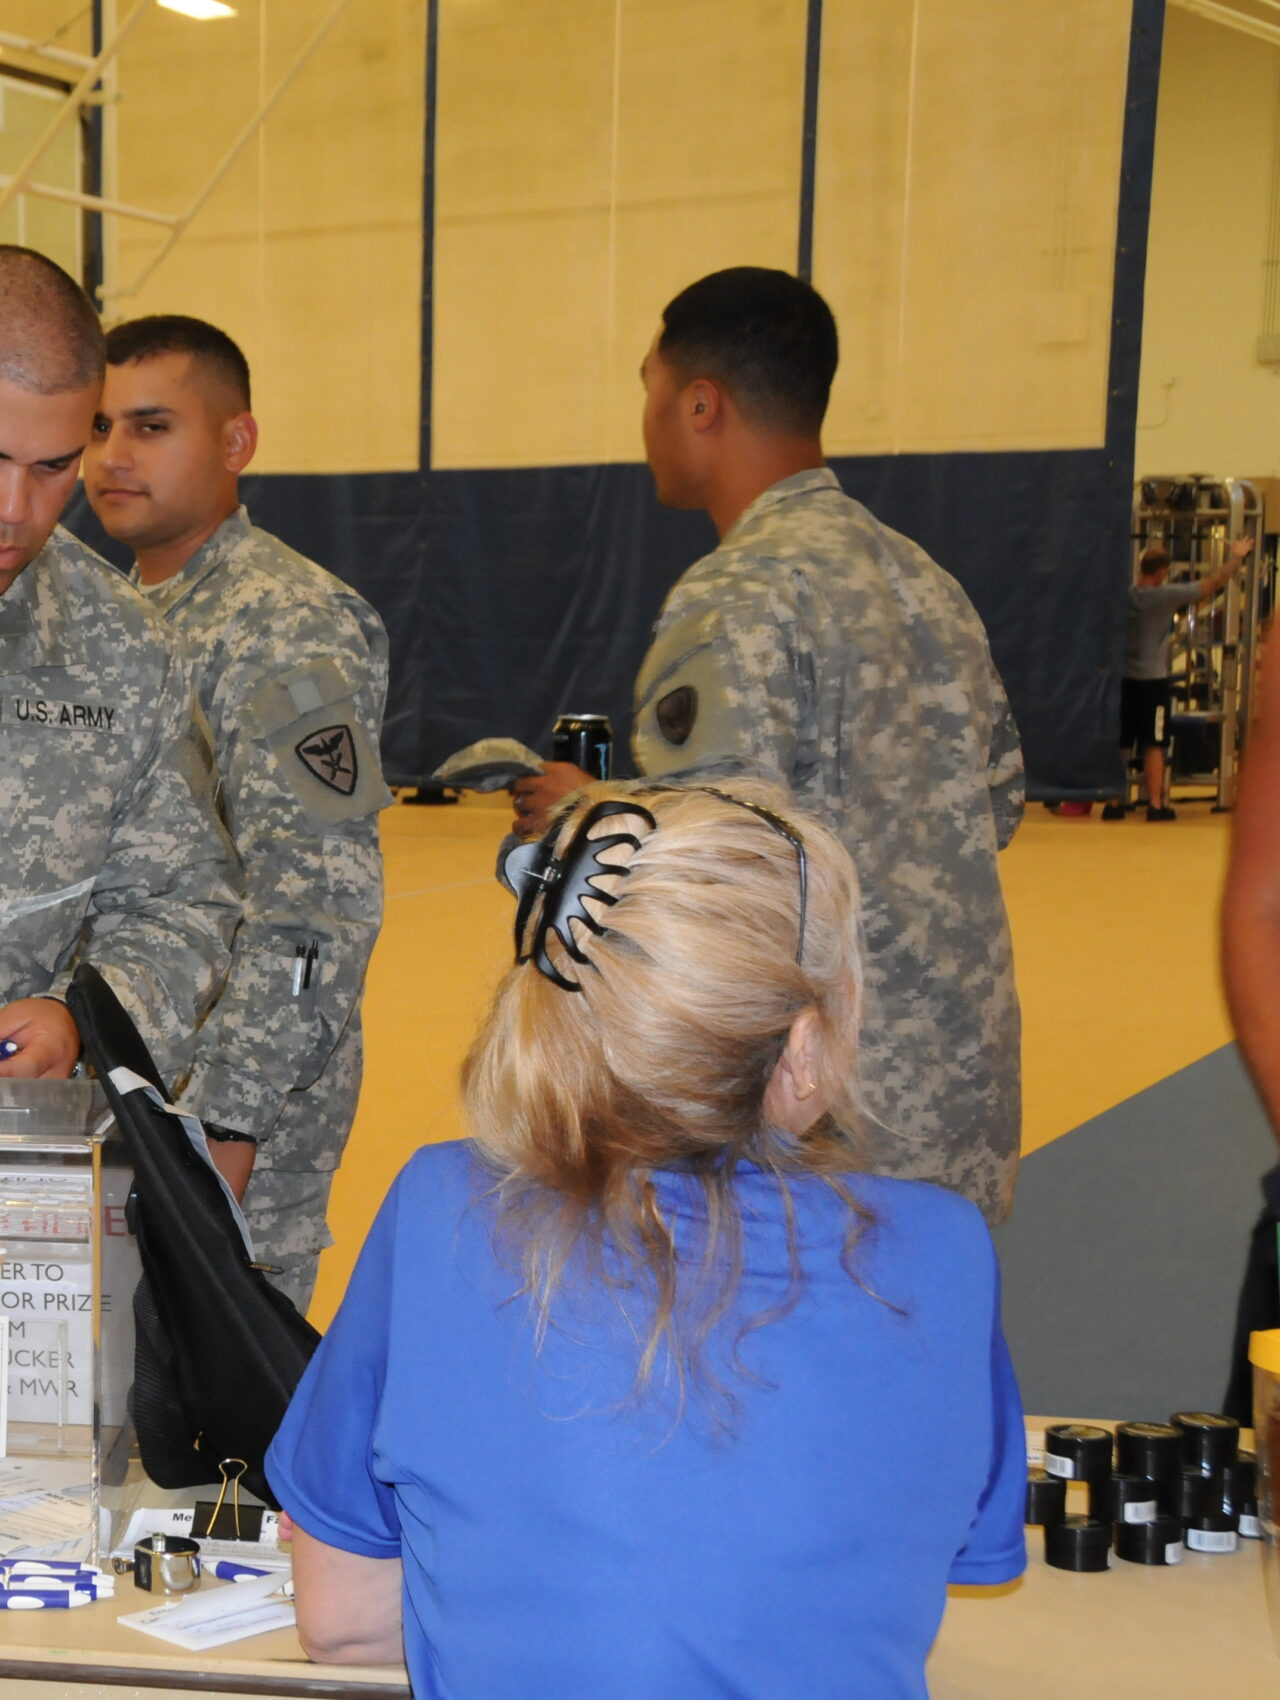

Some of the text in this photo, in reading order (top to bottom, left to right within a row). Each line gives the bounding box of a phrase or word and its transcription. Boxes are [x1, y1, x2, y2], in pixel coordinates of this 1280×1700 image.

[16, 699, 115, 729] U.S. ARMY
[30, 1263, 64, 1281] TO
[43, 1293, 112, 1312] PRIZE
